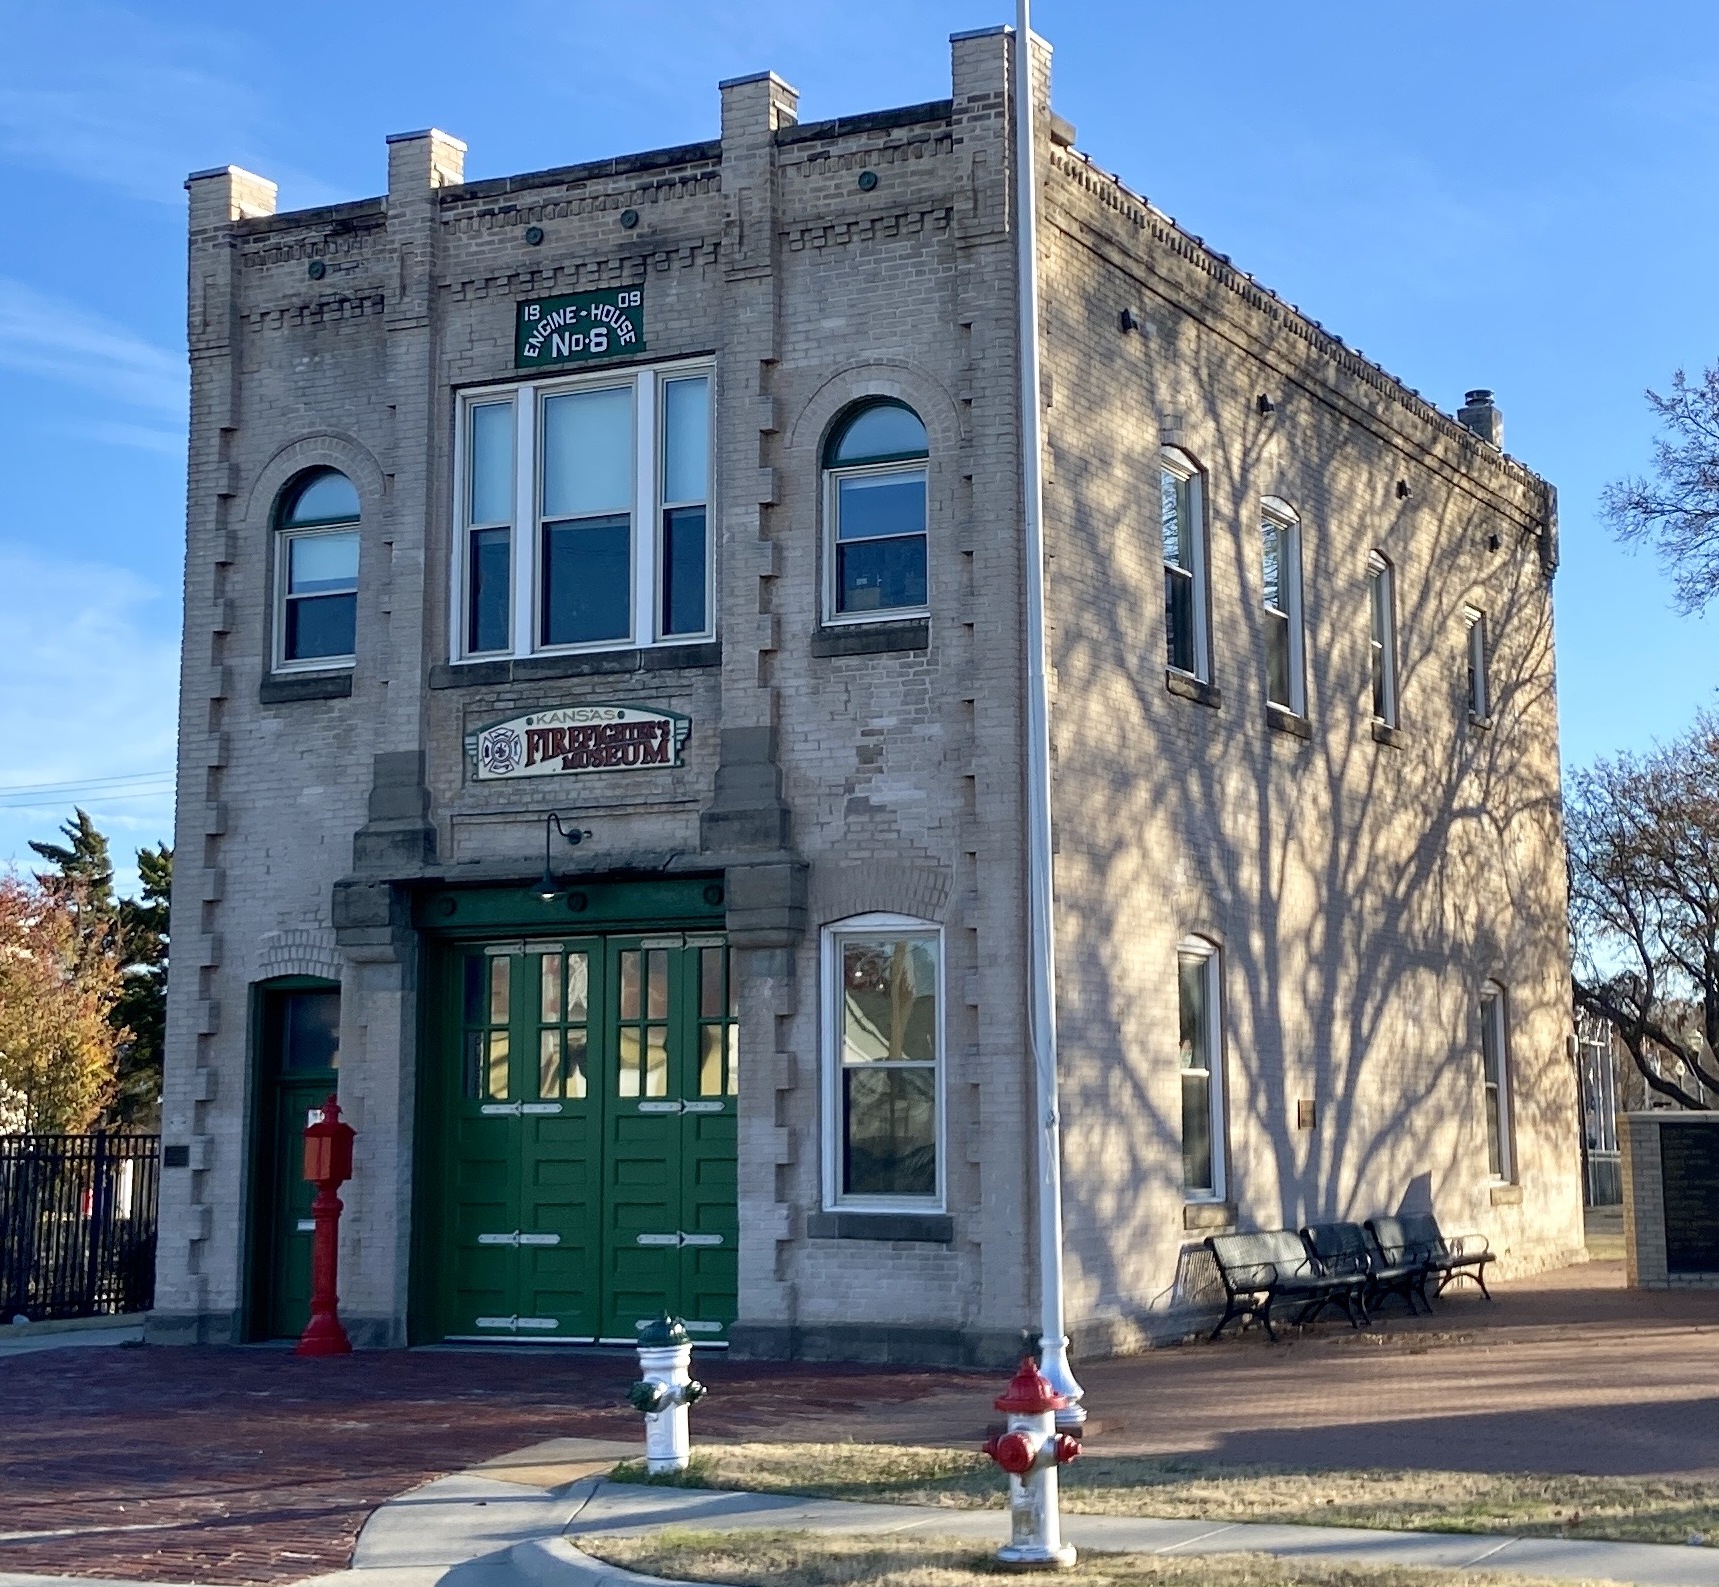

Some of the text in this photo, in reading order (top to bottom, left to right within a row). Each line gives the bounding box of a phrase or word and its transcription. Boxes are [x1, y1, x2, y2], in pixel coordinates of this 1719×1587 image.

[618, 291, 641, 308] 09
[524, 304, 541, 321] 19
[536, 709, 617, 725] KANSAS
[562, 739, 670, 770] MUSEUM
